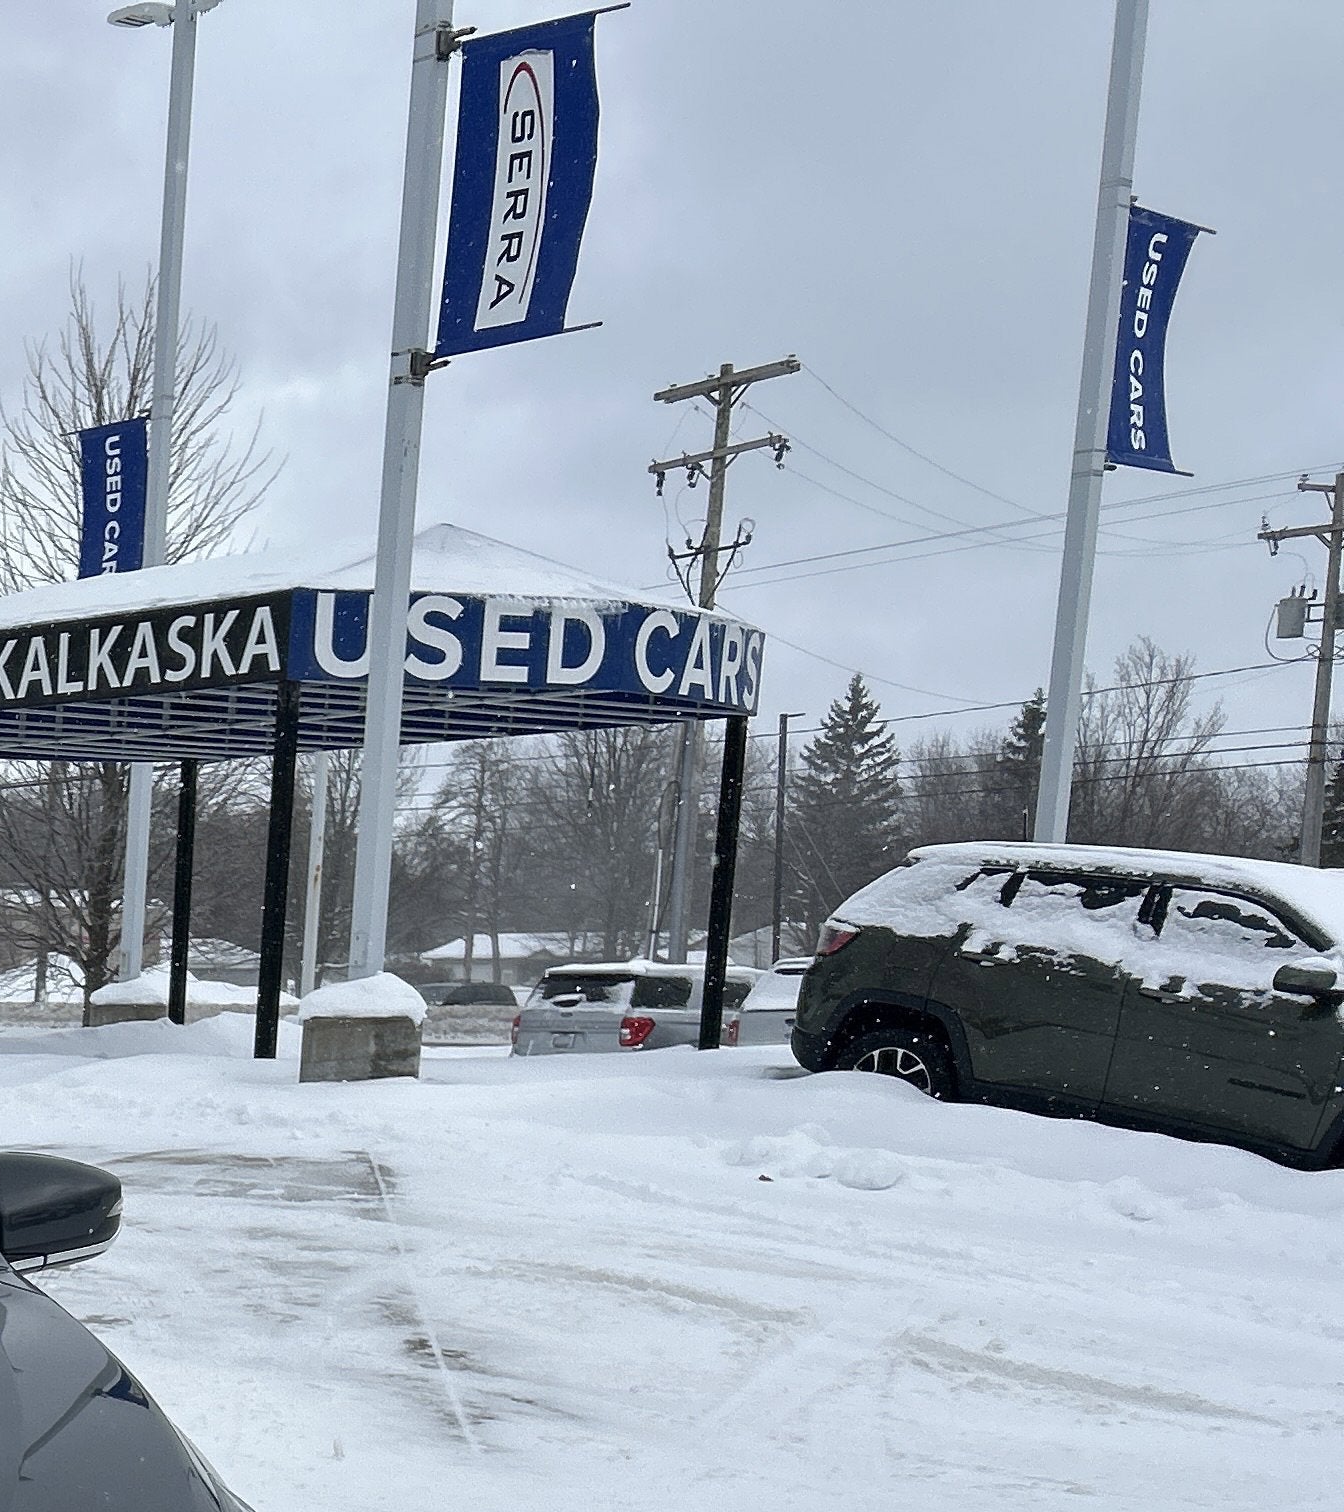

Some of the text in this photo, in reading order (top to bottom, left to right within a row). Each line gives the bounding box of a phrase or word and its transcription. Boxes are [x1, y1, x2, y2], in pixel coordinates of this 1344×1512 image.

[489, 109, 535, 310] SERRA
[1129, 232, 1168, 451] USED CARS
[104, 435, 122, 513] USED
[314, 593, 767, 711] USED CARS
